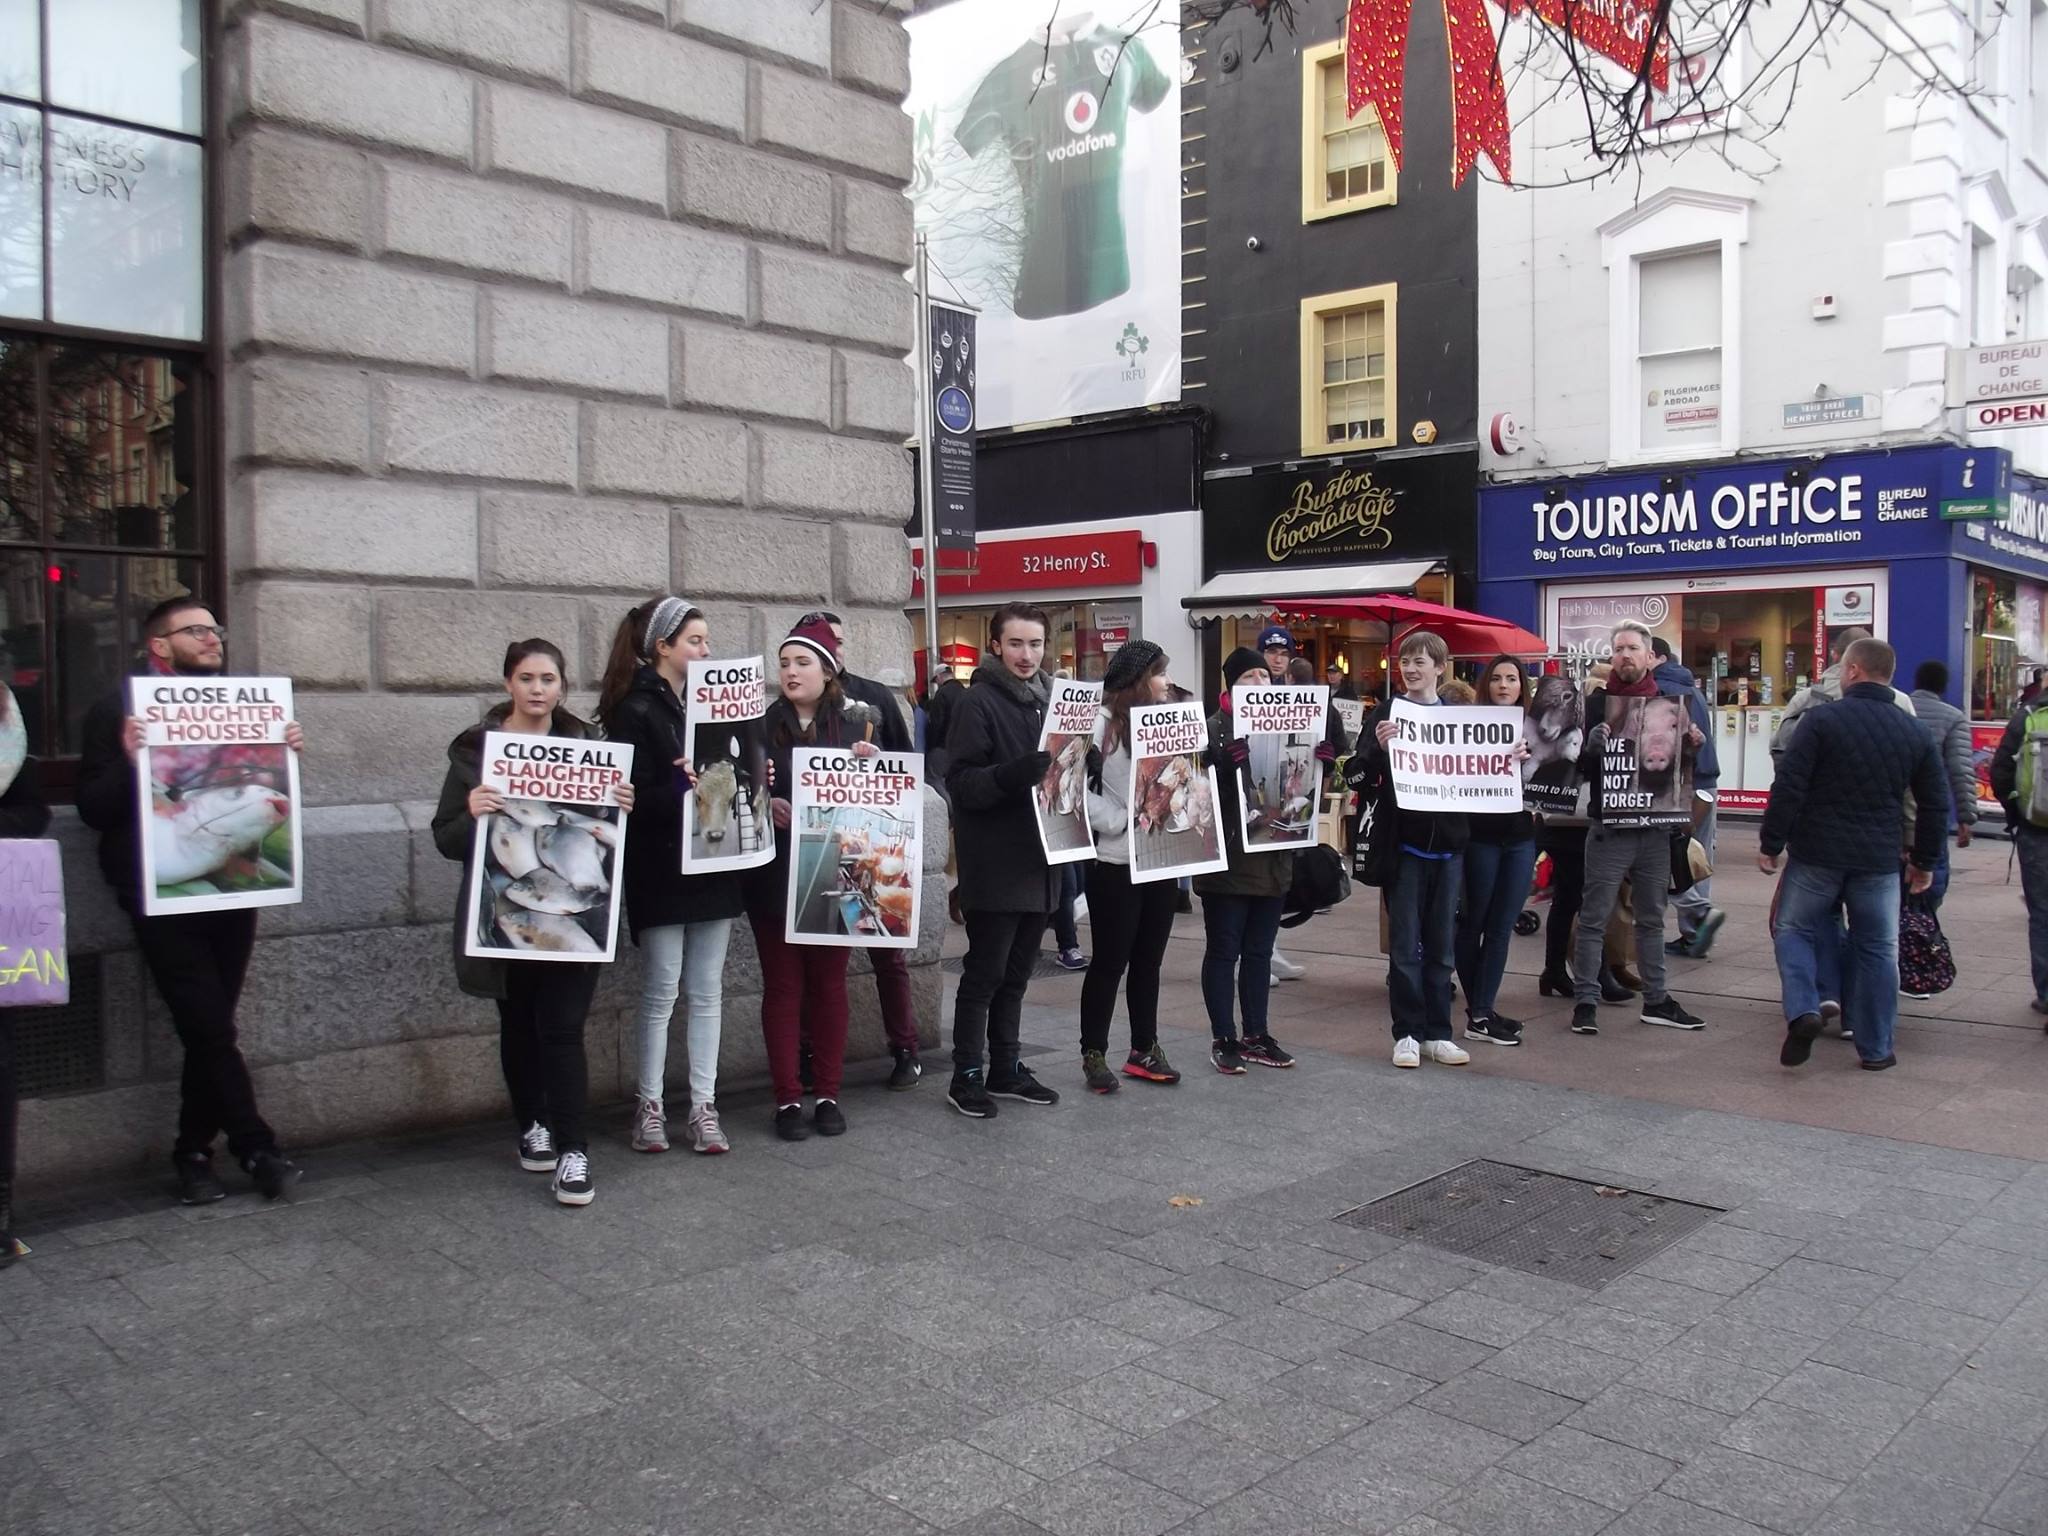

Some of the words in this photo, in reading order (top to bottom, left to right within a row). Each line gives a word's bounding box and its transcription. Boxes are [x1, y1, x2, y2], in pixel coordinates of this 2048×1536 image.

[1047, 132, 1116, 163] vodafone
[0, 154, 138, 202] HITORY
[1979, 347, 2041, 364] BUREAU
[1121, 368, 1146, 382] IRFU
[2000, 365, 2019, 378] DE
[1664, 384, 1720, 396] PILGRIMAGES
[1978, 379, 2042, 397] CHANGE
[1664, 396, 1701, 406] ABROAD
[1786, 414, 1817, 424] HENRY
[1823, 409, 1859, 420] STREET
[1980, 403, 2046, 425] OPEN
[1284, 469, 1372, 524] Butlers
[1878, 487, 1927, 501] BUREAU
[1533, 489, 1698, 542] TOURISM
[1711, 475, 1862, 530] OFFICE
[1878, 500, 1895, 512] DE
[1878, 508, 1928, 521] CHANGE
[1267, 504, 1358, 561] Chocolate
[1533, 549, 1557, 562] Day
[1560, 546, 1597, 560] Tours,
[1600, 544, 1623, 558] City
[1628, 542, 1665, 555] Tours,
[1669, 538, 1713, 553] Tickets
[1716, 536, 1727, 549] &
[1729, 534, 1777, 548] Tourist
[1781, 530, 1861, 547] Information
[1023, 556, 1041, 573] 32
[1044, 554, 1088, 574] Henry
[1091, 551, 1111, 569] St.
[1584, 602, 1606, 618] Day
[1609, 600, 1641, 616] Tours
[1100, 632, 1115, 640] €40
[1815, 609, 1824, 655] Exchange
[704, 667, 753, 686] CLOSE
[154, 686, 228, 705] CLOSE
[236, 687, 275, 704] ALL
[696, 681, 765, 703] SLAUGHT
[1062, 688, 1094, 703] CLOSE
[1245, 692, 1289, 705] CLOSE
[1294, 692, 1317, 705] ALL
[147, 705, 285, 722] SLAUGHTER
[1141, 711, 1180, 727] CLOSE
[1181, 709, 1199, 722] ALL
[1240, 705, 1322, 718] SLAUGHTER
[167, 722, 270, 741] HOUSES!
[1137, 721, 1205, 742] SLAUGHTER
[1251, 717, 1311, 731] HOUSES!
[1395, 717, 1417, 742] IT'S
[1420, 723, 1458, 745] NOT
[1463, 723, 1514, 745] FOOD
[1146, 736, 1199, 755] HOUSES!
[1605, 738, 1625, 753] WE
[504, 742, 574, 764] CLOSE
[580, 750, 616, 768] ALL
[1393, 748, 1418, 773] IT'S
[1422, 753, 1514, 777] VIOLENCE
[1603, 757, 1637, 771] WILL
[493, 759, 623, 786] SLAUGHTER
[809, 756, 869, 773] CLOSE
[873, 758, 908, 774] ALL
[509, 779, 606, 802] HOUSES!
[801, 772, 915, 791] SLAUGHTER
[1524, 783, 1548, 794] want
[1550, 785, 1561, 795] to
[1561, 785, 1579, 797] live.
[1603, 775, 1630, 790] NOT
[816, 788, 900, 806] HOUSES!
[1414, 784, 1438, 796] ACTION
[1459, 787, 1514, 798] EVERYWHERE
[1740, 795, 1767, 803] Secure
[1602, 793, 1654, 808] FORGET
